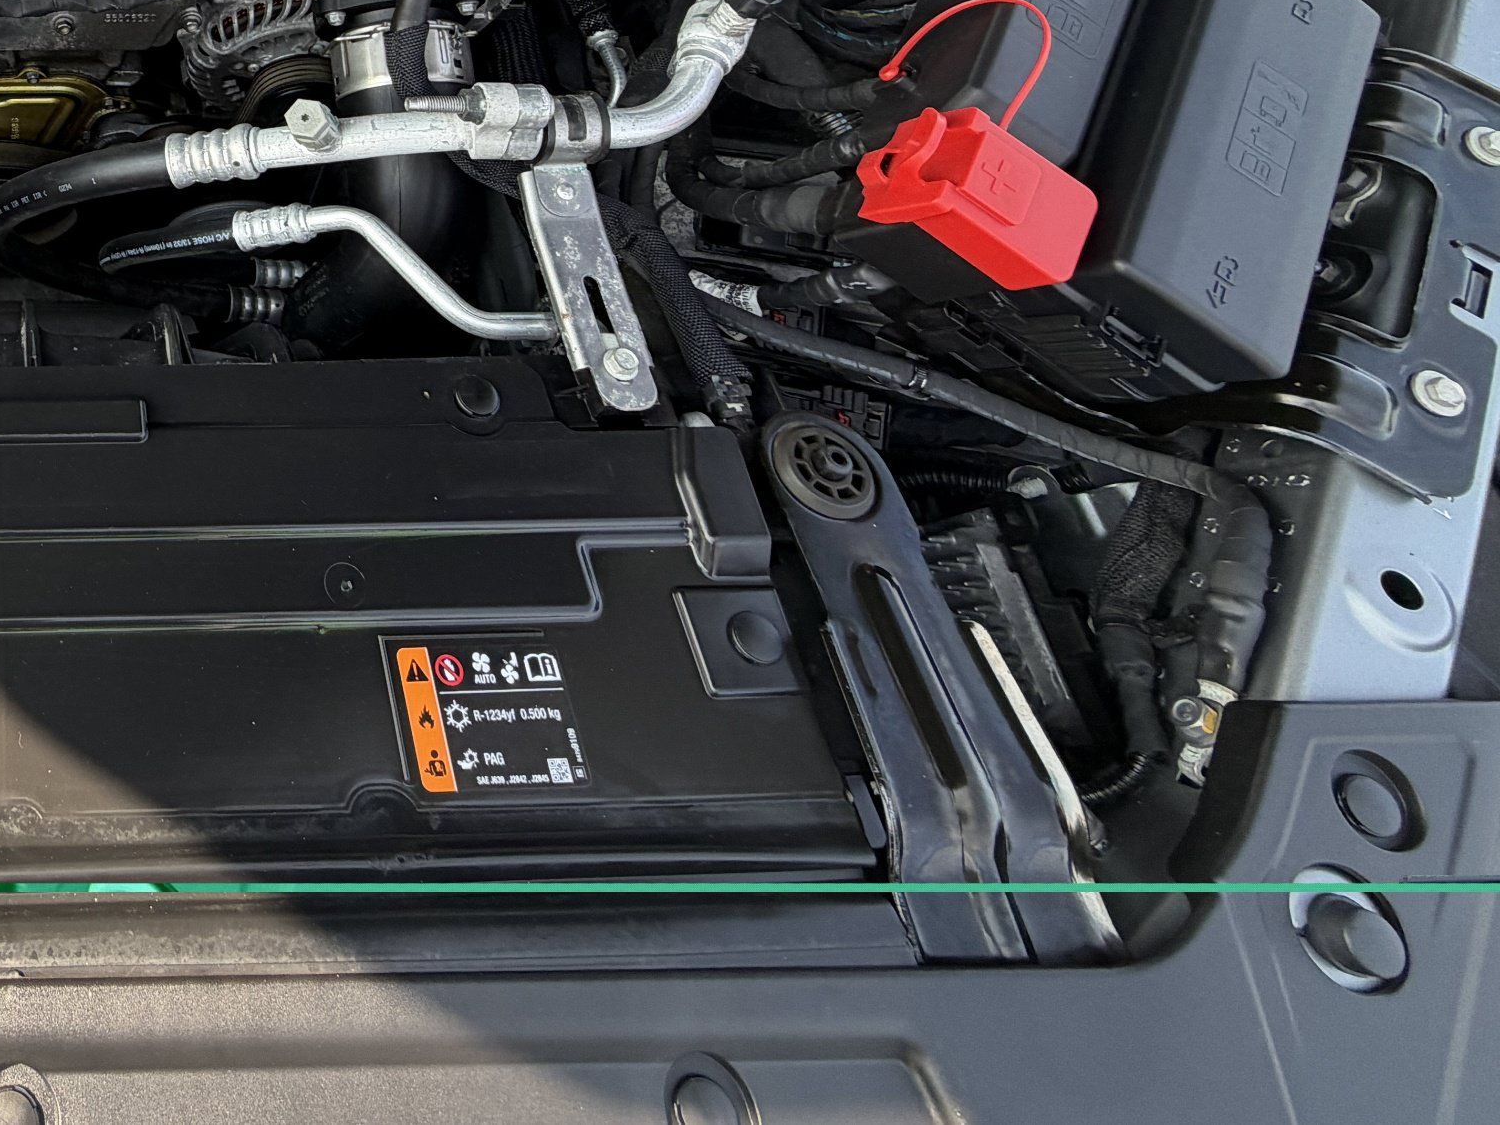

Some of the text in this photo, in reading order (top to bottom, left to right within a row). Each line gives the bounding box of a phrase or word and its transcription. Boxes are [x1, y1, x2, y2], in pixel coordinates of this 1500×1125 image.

[191, 235, 215, 246] HOSE
[216, 232, 231, 242] A/C
[173, 238, 191, 248] 13/32
[474, 673, 497, 684] AUTO
[473, 707, 562, 723] R-1234yf 0.500 kg
[483, 751, 506, 766] PAG
[476, 775, 490, 785] SAE
